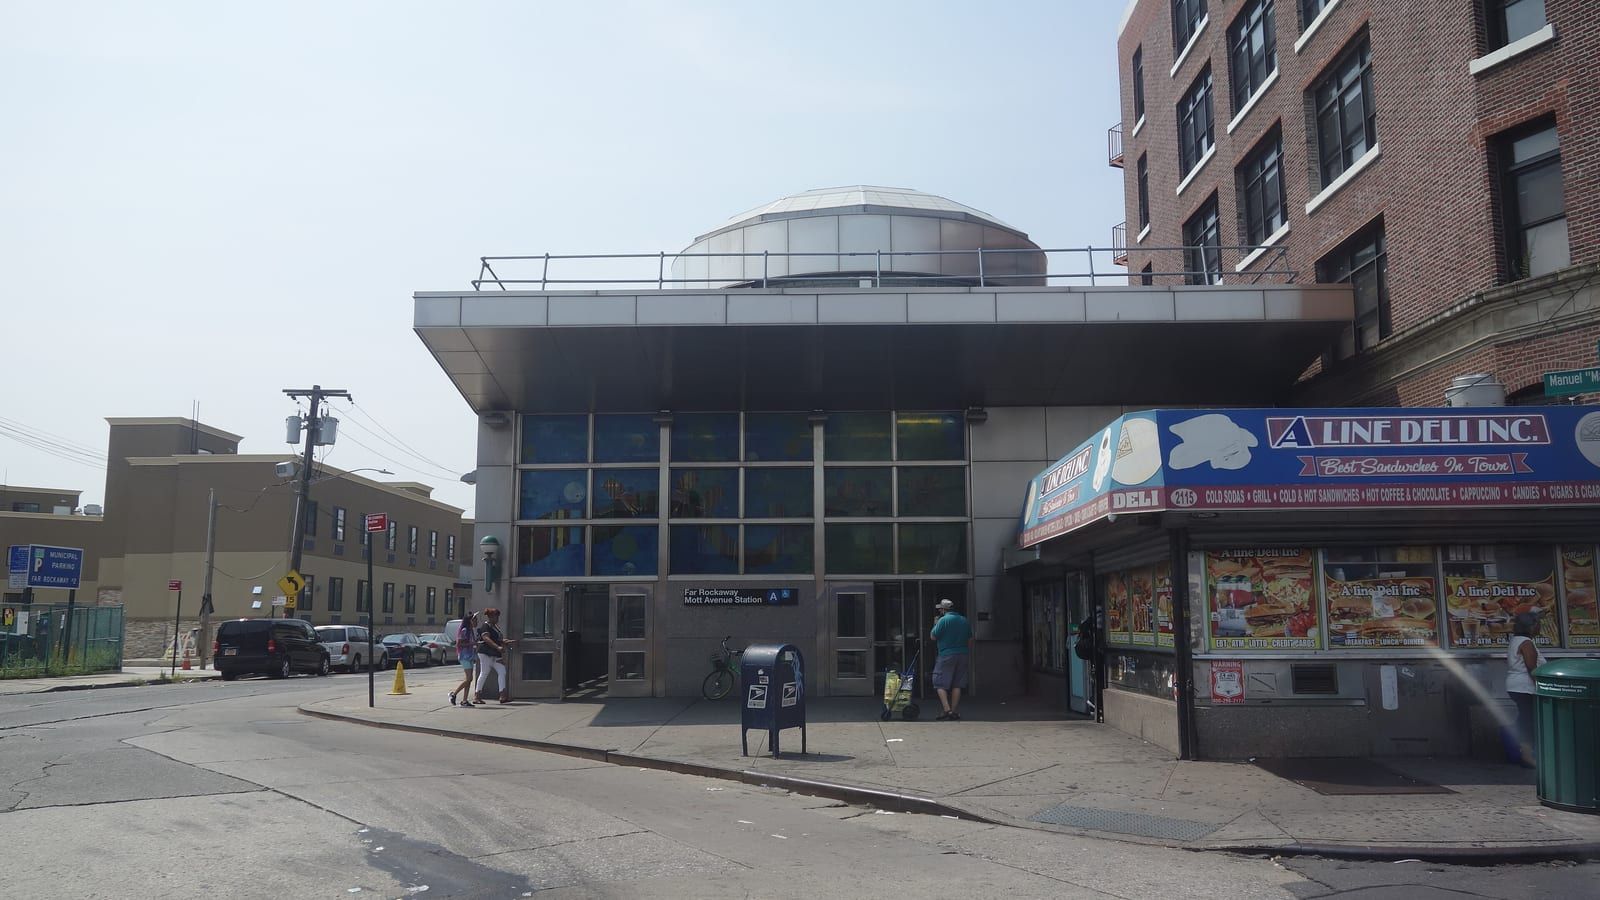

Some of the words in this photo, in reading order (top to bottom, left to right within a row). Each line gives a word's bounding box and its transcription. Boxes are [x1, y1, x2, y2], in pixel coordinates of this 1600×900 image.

[1550, 373, 1583, 386] Manuel
[1271, 416, 1314, 449] A
[1323, 421, 1391, 444] LINE
[1400, 420, 1468, 443] DELI
[1479, 418, 1538, 442] INC.
[1320, 458, 1361, 475] Best
[1361, 458, 1439, 474] Sandwiches
[1445, 457, 1464, 473] In
[1468, 456, 1510, 472] Town
[1113, 490, 1159, 508] DELI
[1175, 491, 1194, 505] 2115
[1206, 490, 1222, 503] COLD
[1224, 490, 1245, 503] SODAS
[1253, 490, 1271, 503] GRILL
[1280, 489, 1296, 503] COLD
[1298, 489, 1303, 502] &
[1304, 489, 1317, 502] HOT
[1319, 488, 1360, 502] SANDWICHES
[1366, 488, 1379, 502] HOT
[1381, 488, 1404, 501] COFFEE
[1406, 488, 1411, 501] &
[1412, 487, 1450, 501] CHOCOLATE
[1460, 487, 1500, 500] CAPPUCCINO
[1512, 486, 1539, 500] CANDIES
[1550, 485, 1574, 499] CIGARS
[1575, 485, 1580, 498] &
[50, 551, 78, 560] MUNICIPAL
[52, 562, 75, 570] PARKING
[699, 588, 739, 597] Rockaway
[1341, 586, 1350, 596] A
[1353, 585, 1374, 596] line
[1377, 585, 1399, 596] Deli
[1402, 585, 1420, 596] Inc
[1457, 586, 1466, 597] A
[1468, 586, 1489, 597] line
[1492, 586, 1515, 596] Deli
[1518, 586, 1536, 596] Inc
[684, 596, 703, 604] Mott
[734, 596, 762, 604] Station
[769, 592, 778, 601] A
[1216, 639, 1228, 648] EBT
[1231, 639, 1245, 648] ATM
[1249, 639, 1268, 648] LOTTO
[1272, 639, 1293, 648] CREDIT
[1477, 637, 1492, 645] ATM
[1212, 660, 1241, 668] WARNING
